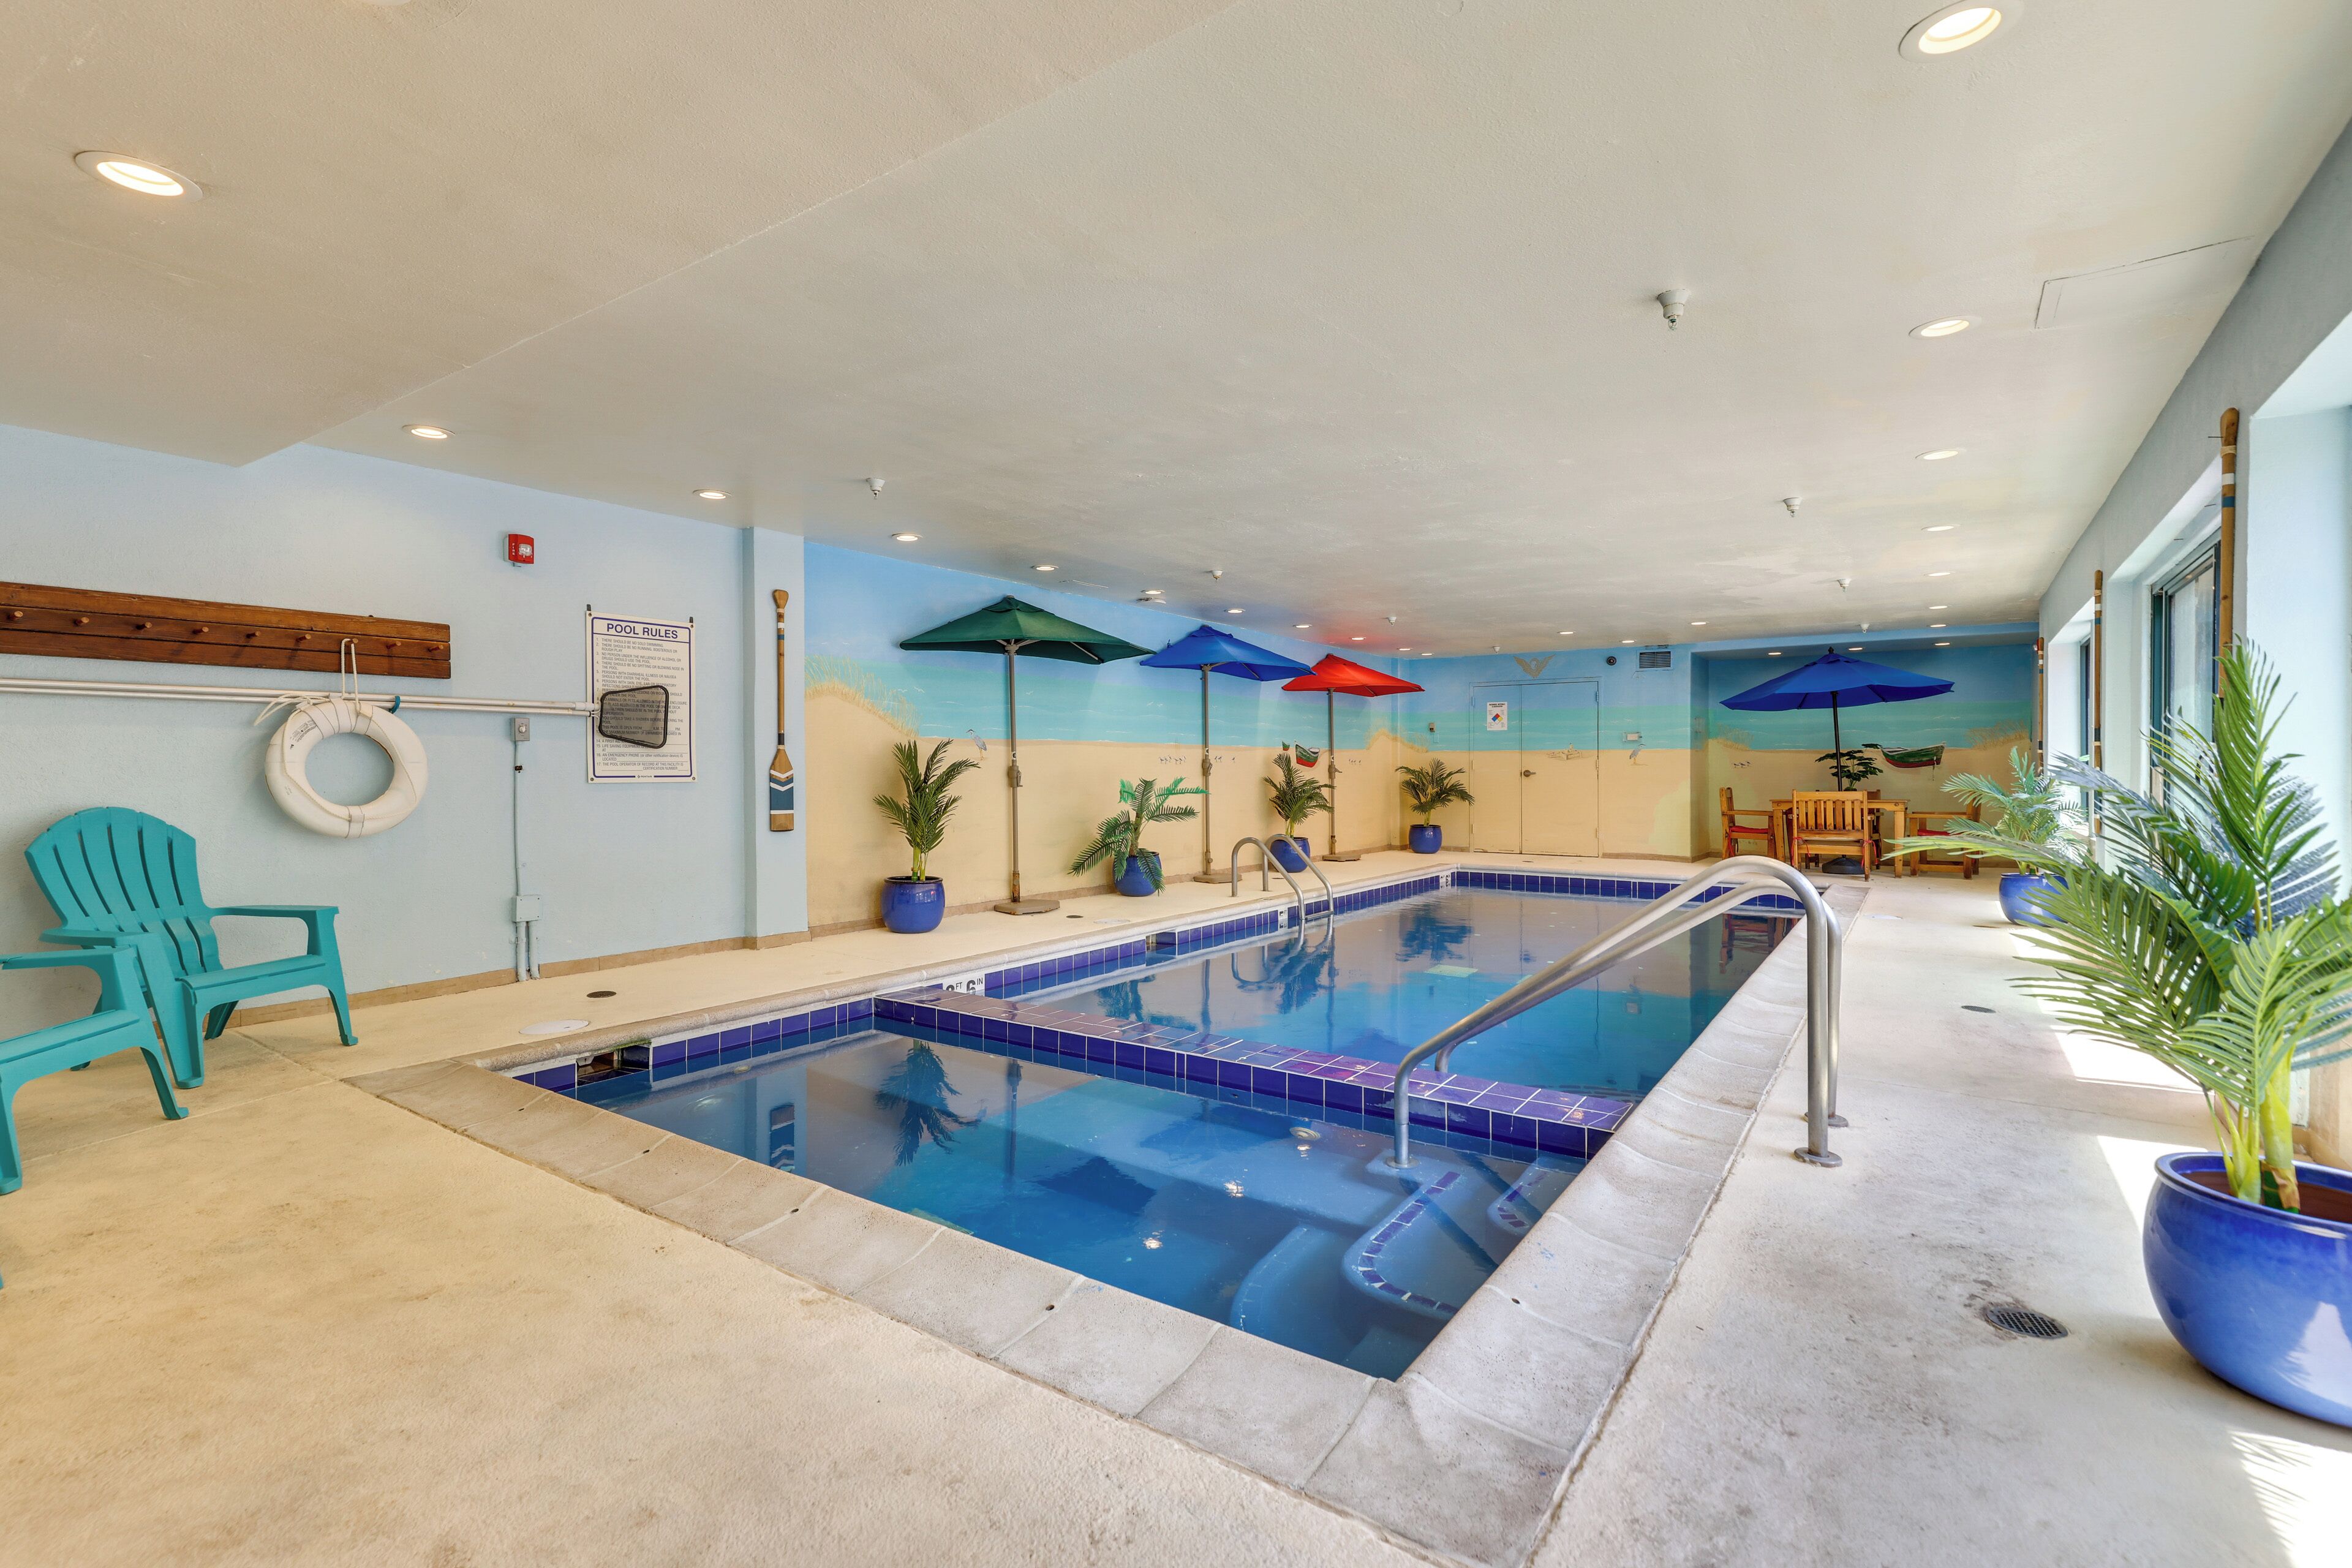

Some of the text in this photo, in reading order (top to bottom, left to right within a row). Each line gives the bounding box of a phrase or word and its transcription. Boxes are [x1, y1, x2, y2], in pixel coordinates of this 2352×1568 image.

[607, 623, 678, 639] POOL RULES
[966, 979, 976, 995] 6
